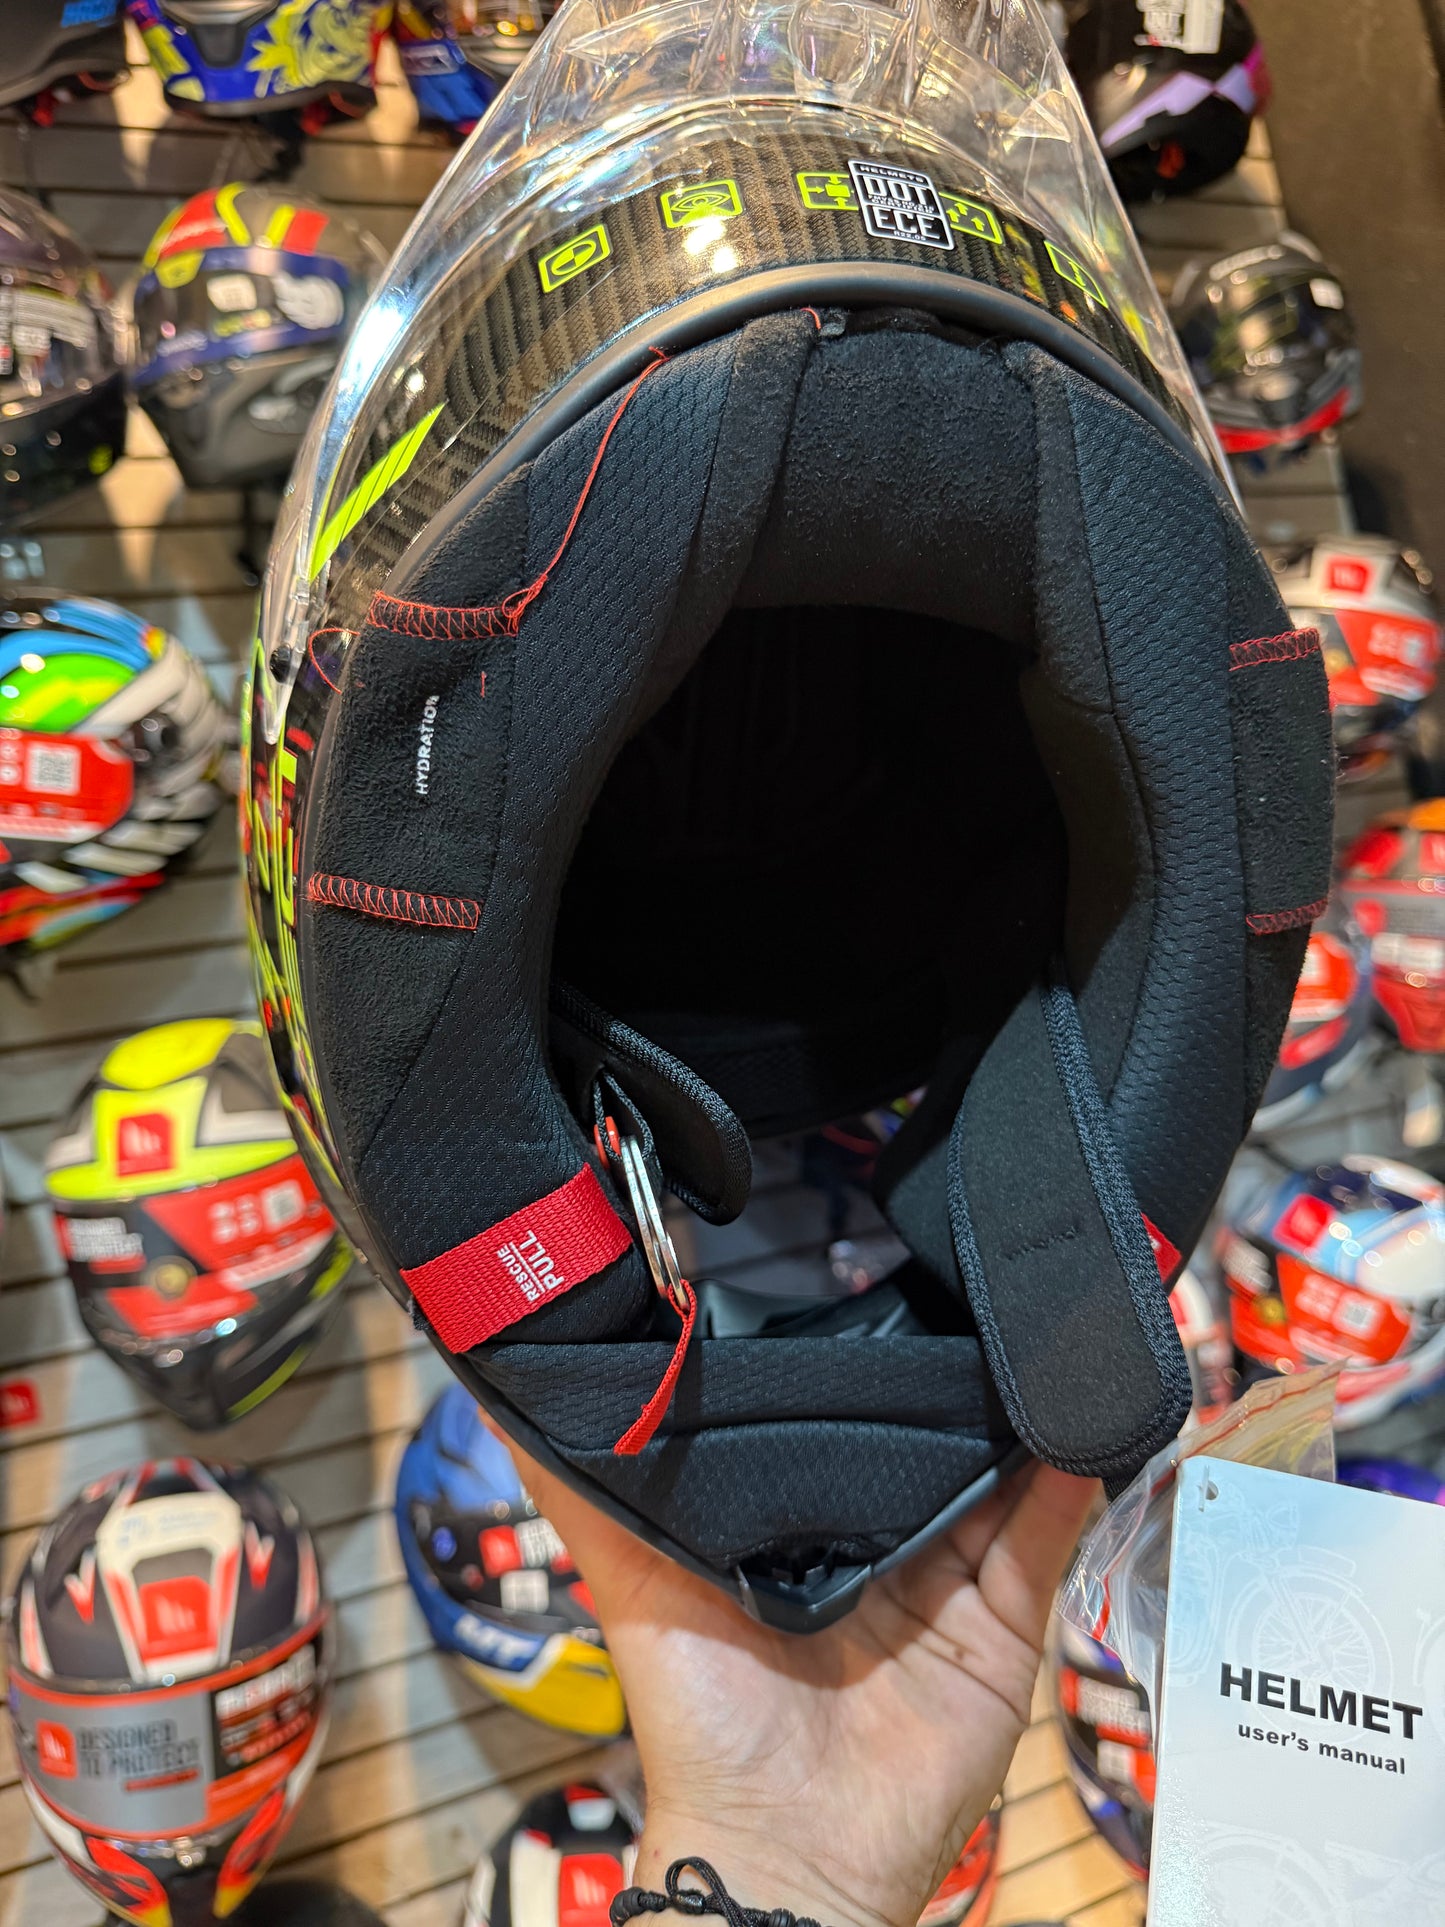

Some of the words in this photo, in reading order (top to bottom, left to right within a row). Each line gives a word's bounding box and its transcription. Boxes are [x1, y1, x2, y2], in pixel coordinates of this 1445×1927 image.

[860, 166, 924, 183] HELMETS
[863, 176, 927, 205] DOT
[872, 206, 940, 239] ECE
[496, 1244, 540, 1302] RESCUE
[519, 1230, 565, 1290] PULL
[1220, 1662, 1423, 1740] HELMET
[1239, 1724, 1309, 1751] user’s
[1319, 1742, 1406, 1774] manual
